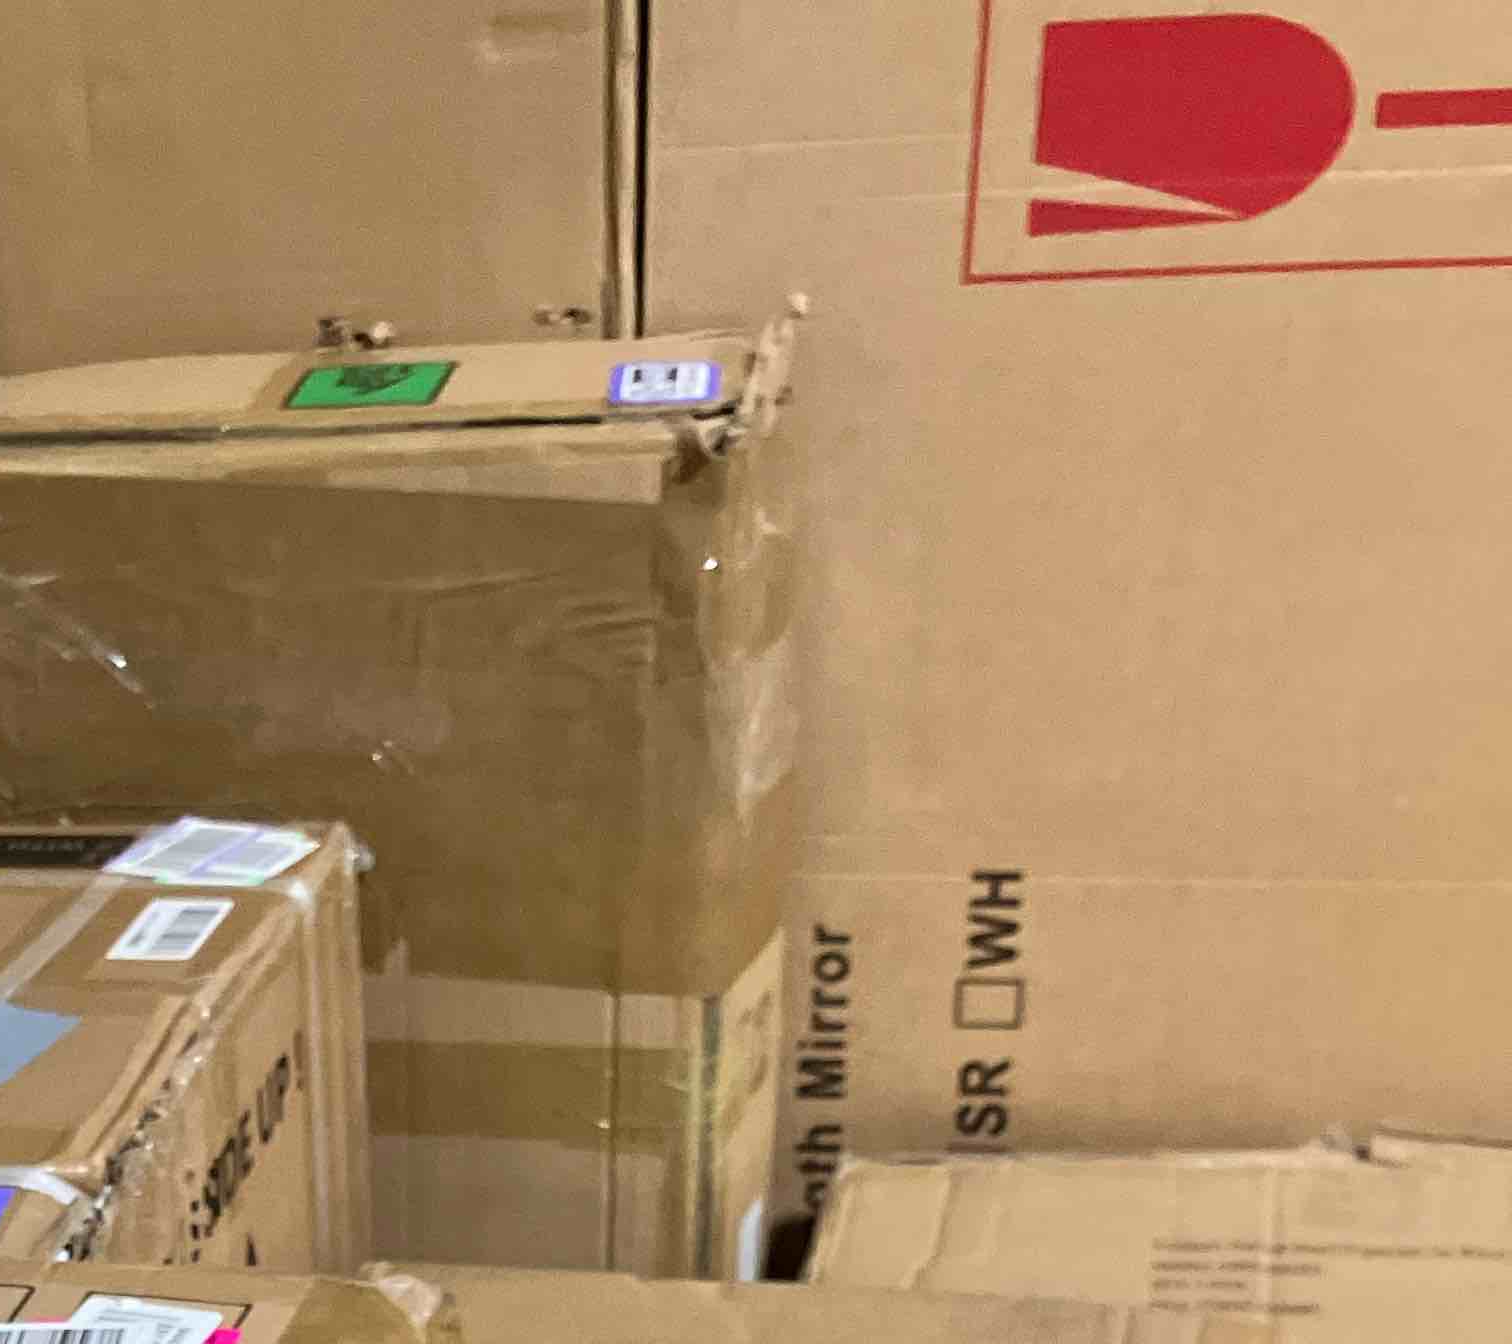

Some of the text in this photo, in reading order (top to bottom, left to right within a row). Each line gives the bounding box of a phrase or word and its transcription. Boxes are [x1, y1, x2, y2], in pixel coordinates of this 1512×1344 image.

[795, 922, 852, 1100] Mirror
[955, 867, 1024, 1137] SR WH
